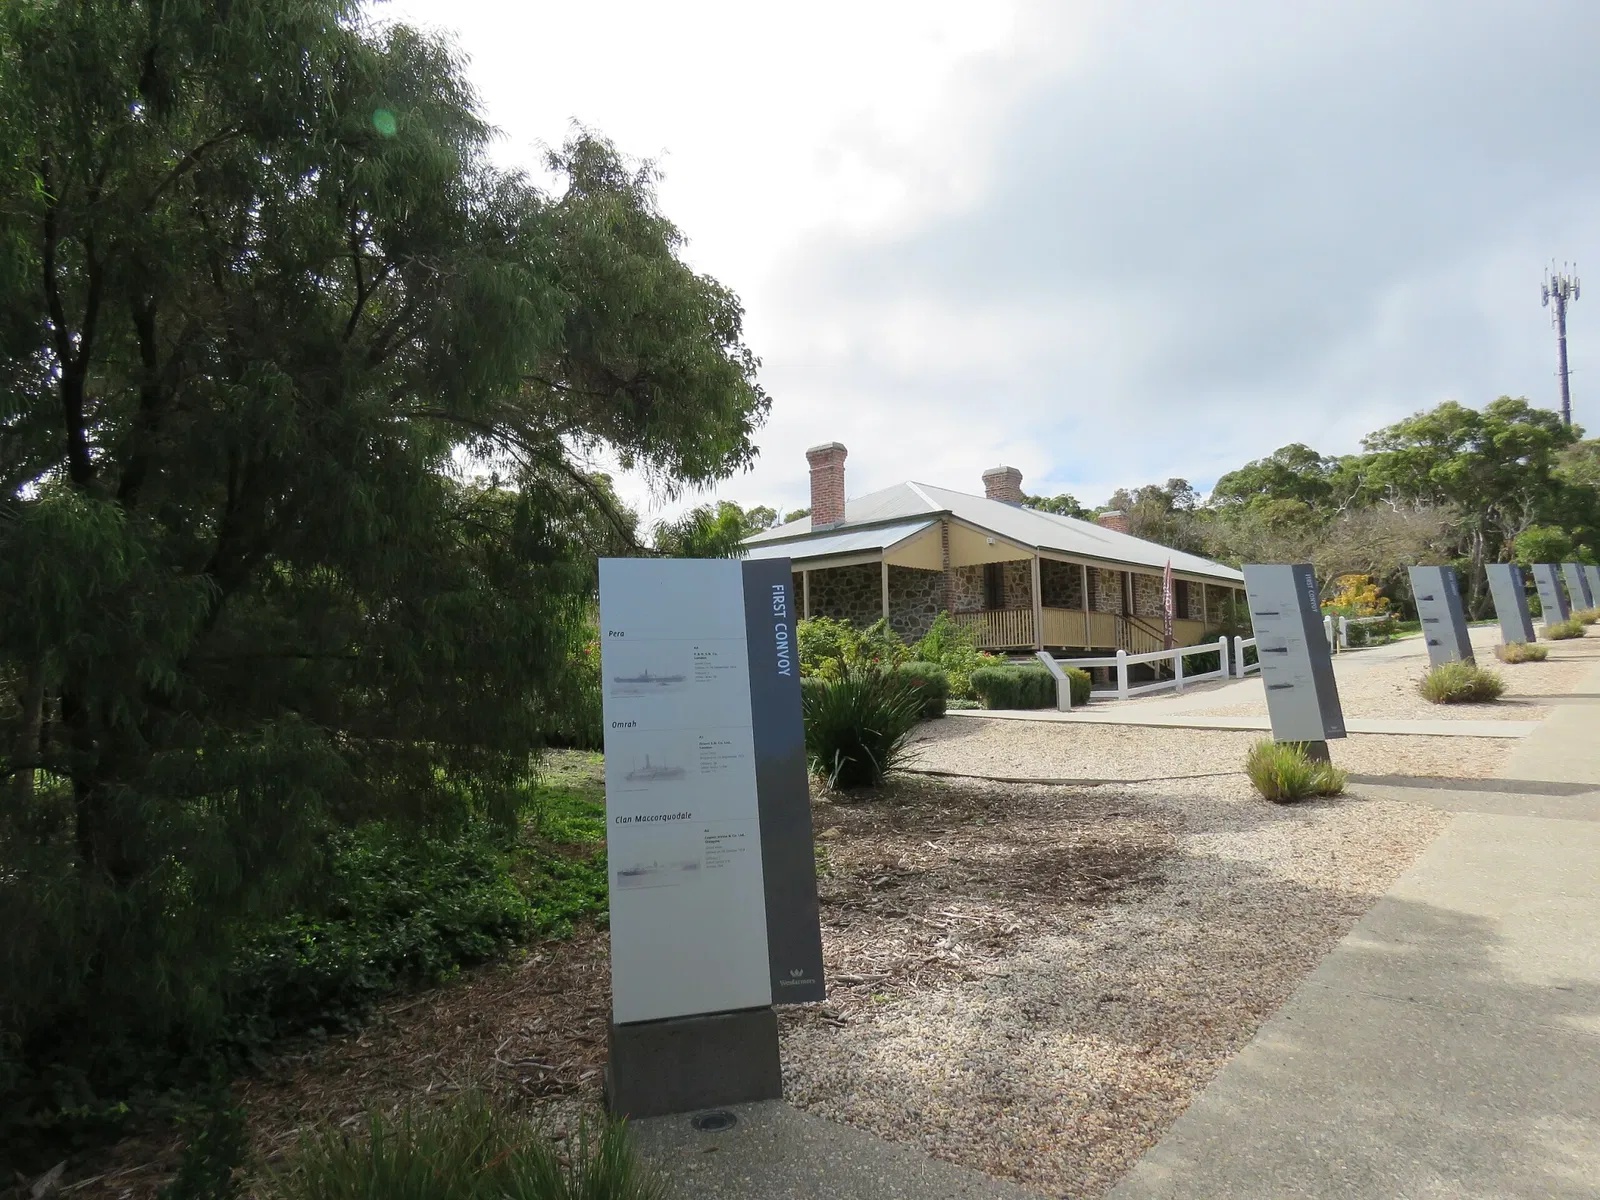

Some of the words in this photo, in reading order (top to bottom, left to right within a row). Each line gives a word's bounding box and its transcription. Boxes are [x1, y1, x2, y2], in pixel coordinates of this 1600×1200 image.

[772, 584, 786, 618] FIRST
[774, 623, 791, 677] CONVOY
[611, 720, 637, 729] Omrah
[615, 815, 632, 824] Clan
[635, 811, 692, 823] Maccorquodale
